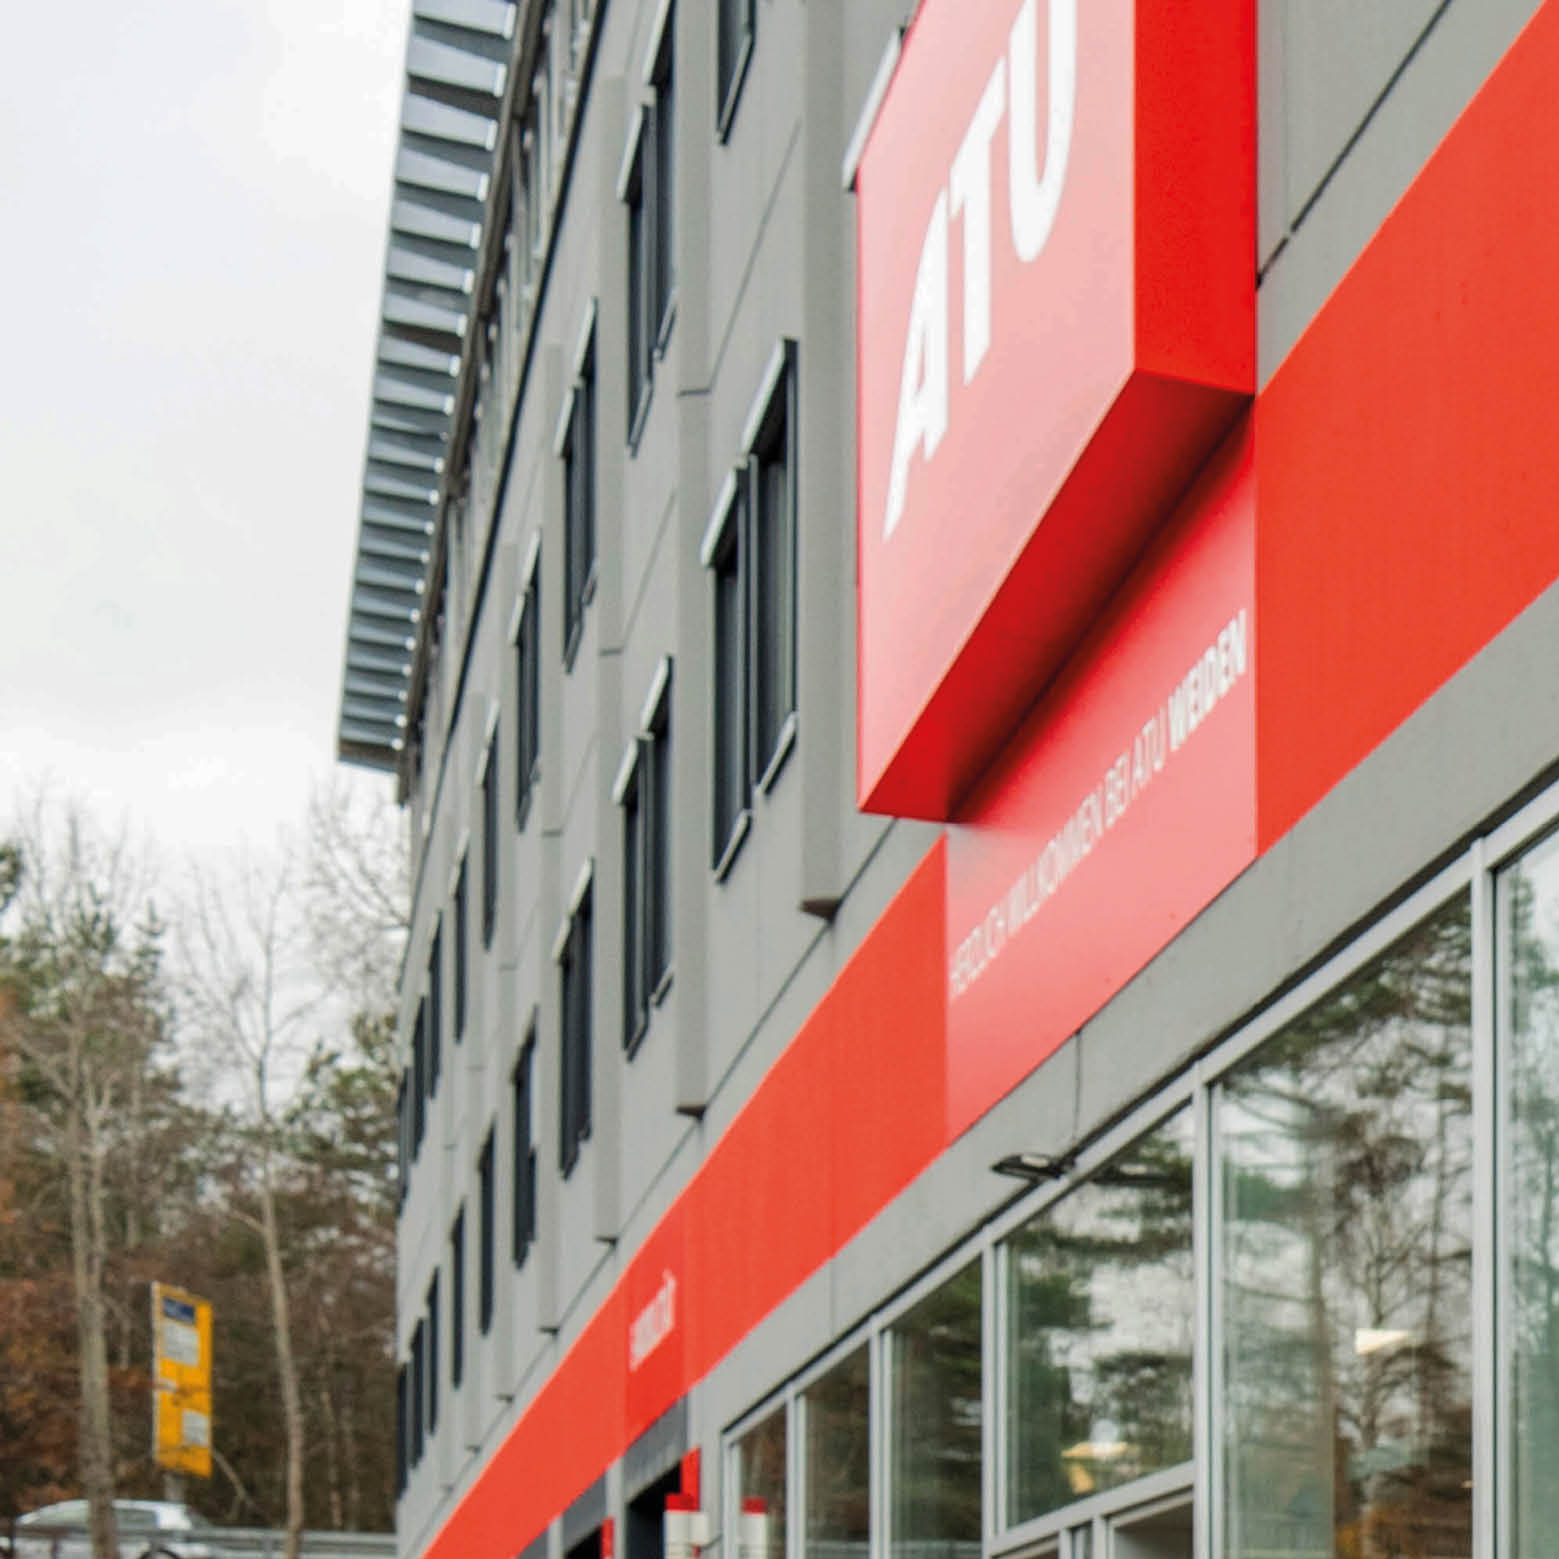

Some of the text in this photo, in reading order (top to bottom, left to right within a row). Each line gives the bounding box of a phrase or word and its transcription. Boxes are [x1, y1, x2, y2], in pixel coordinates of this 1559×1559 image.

[883, 0, 1077, 542] ATU
[1104, 747, 1131, 829] BEI
[1132, 703, 1166, 801] ATU
[1168, 607, 1247, 752] WEIDEN
